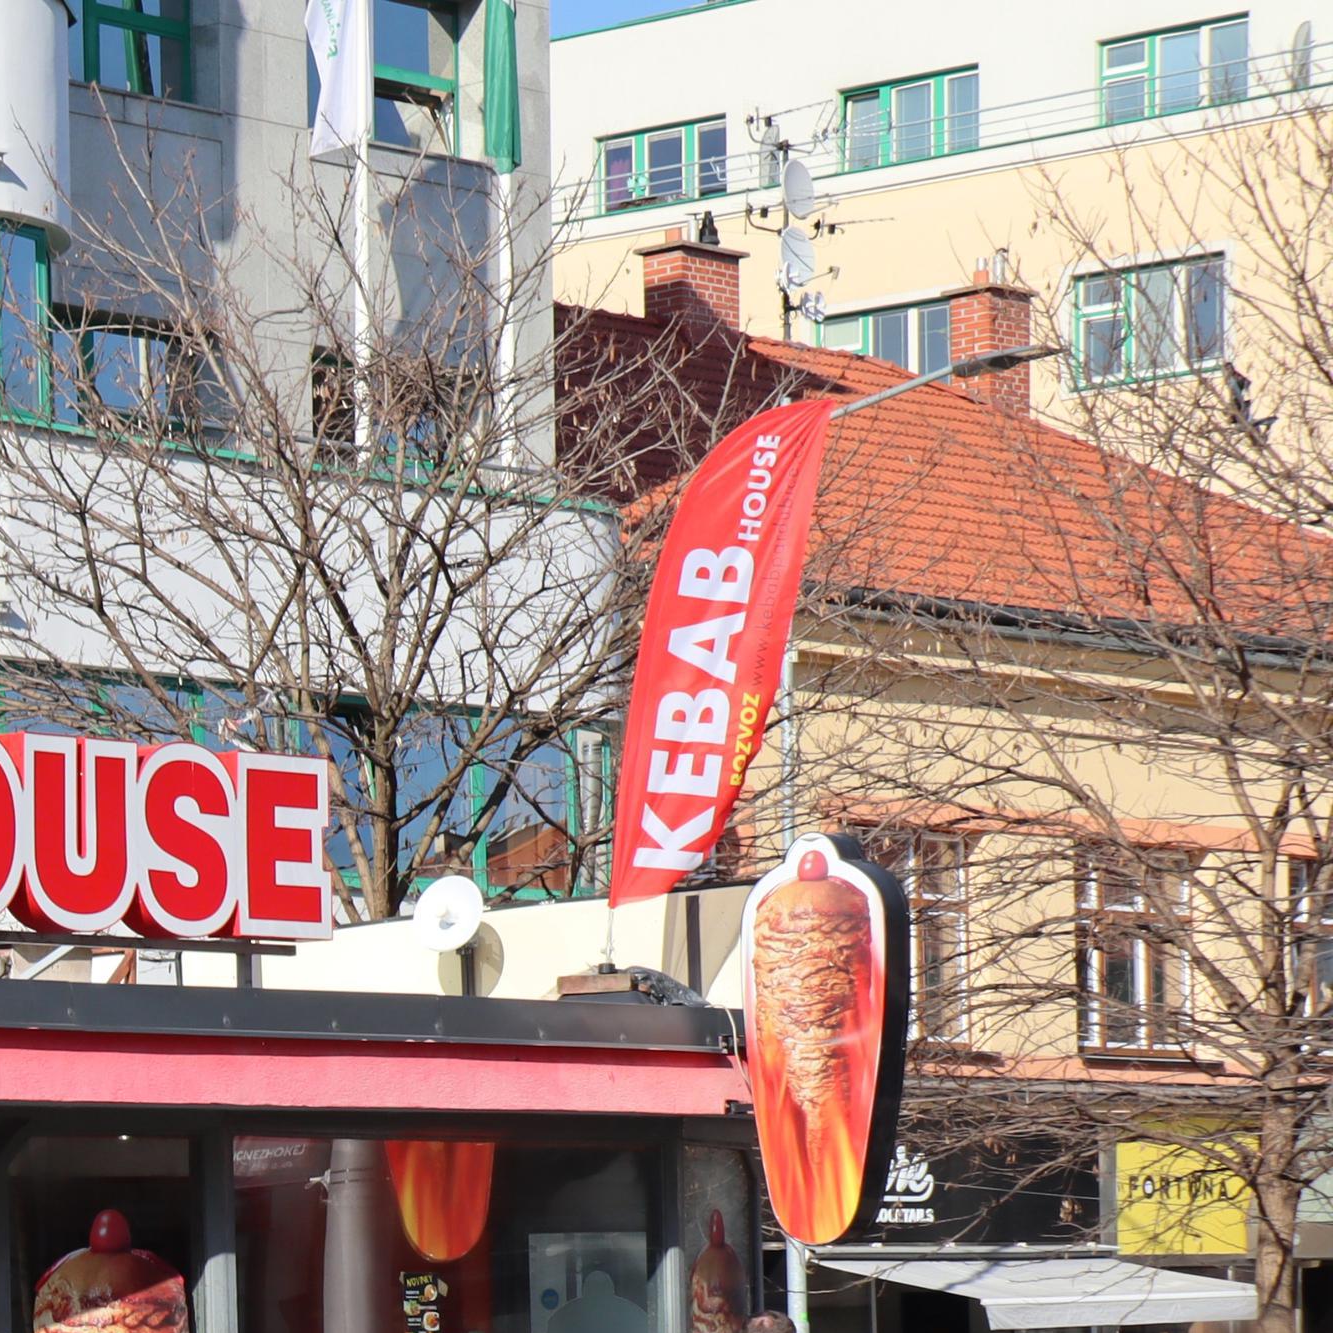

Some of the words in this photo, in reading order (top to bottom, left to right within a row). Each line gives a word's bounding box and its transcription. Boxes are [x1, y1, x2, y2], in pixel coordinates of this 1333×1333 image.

[632, 545, 756, 874] KEBAB
[737, 434, 782, 542] HOUSE
[730, 692, 762, 788] ROZVOZ
[1128, 1174, 1230, 1200] FORTUNA
